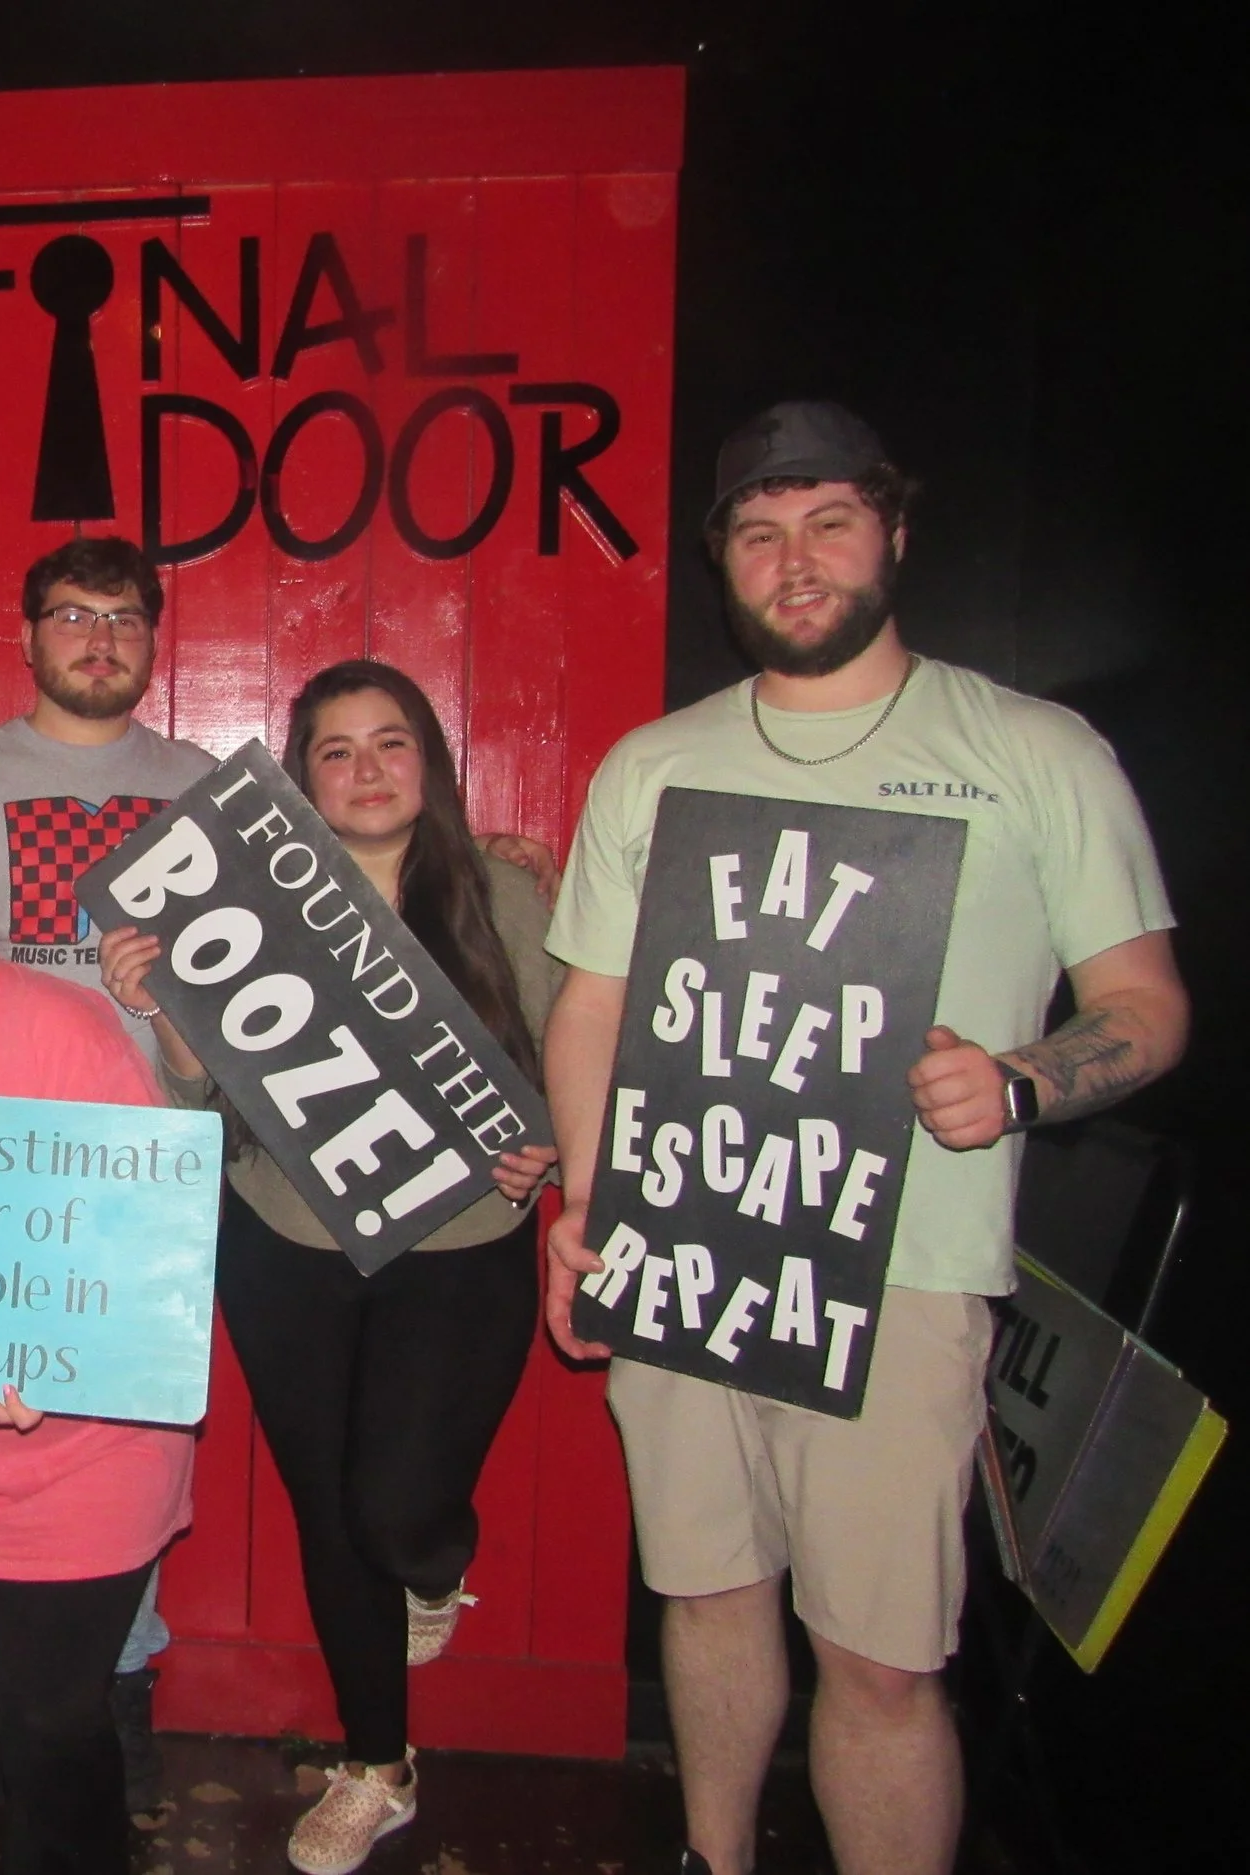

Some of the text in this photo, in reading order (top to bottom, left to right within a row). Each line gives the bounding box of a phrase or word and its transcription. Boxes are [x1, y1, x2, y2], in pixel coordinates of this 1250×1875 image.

[142, 382, 639, 565] DOOR
[878, 782, 939, 796] SALT
[11, 946, 101, 965] MUSIC TE
[709, 829, 875, 951] EAT
[108, 815, 471, 1237] BOOZE!
[210, 768, 528, 1156] I FOUND THE
[652, 957, 884, 1094] SLEEP
[25, 1197, 85, 1244] of
[611, 1088, 887, 1241] ESCAPE
[65, 1268, 108, 1315] in
[579, 1222, 867, 1391] REPEAT
